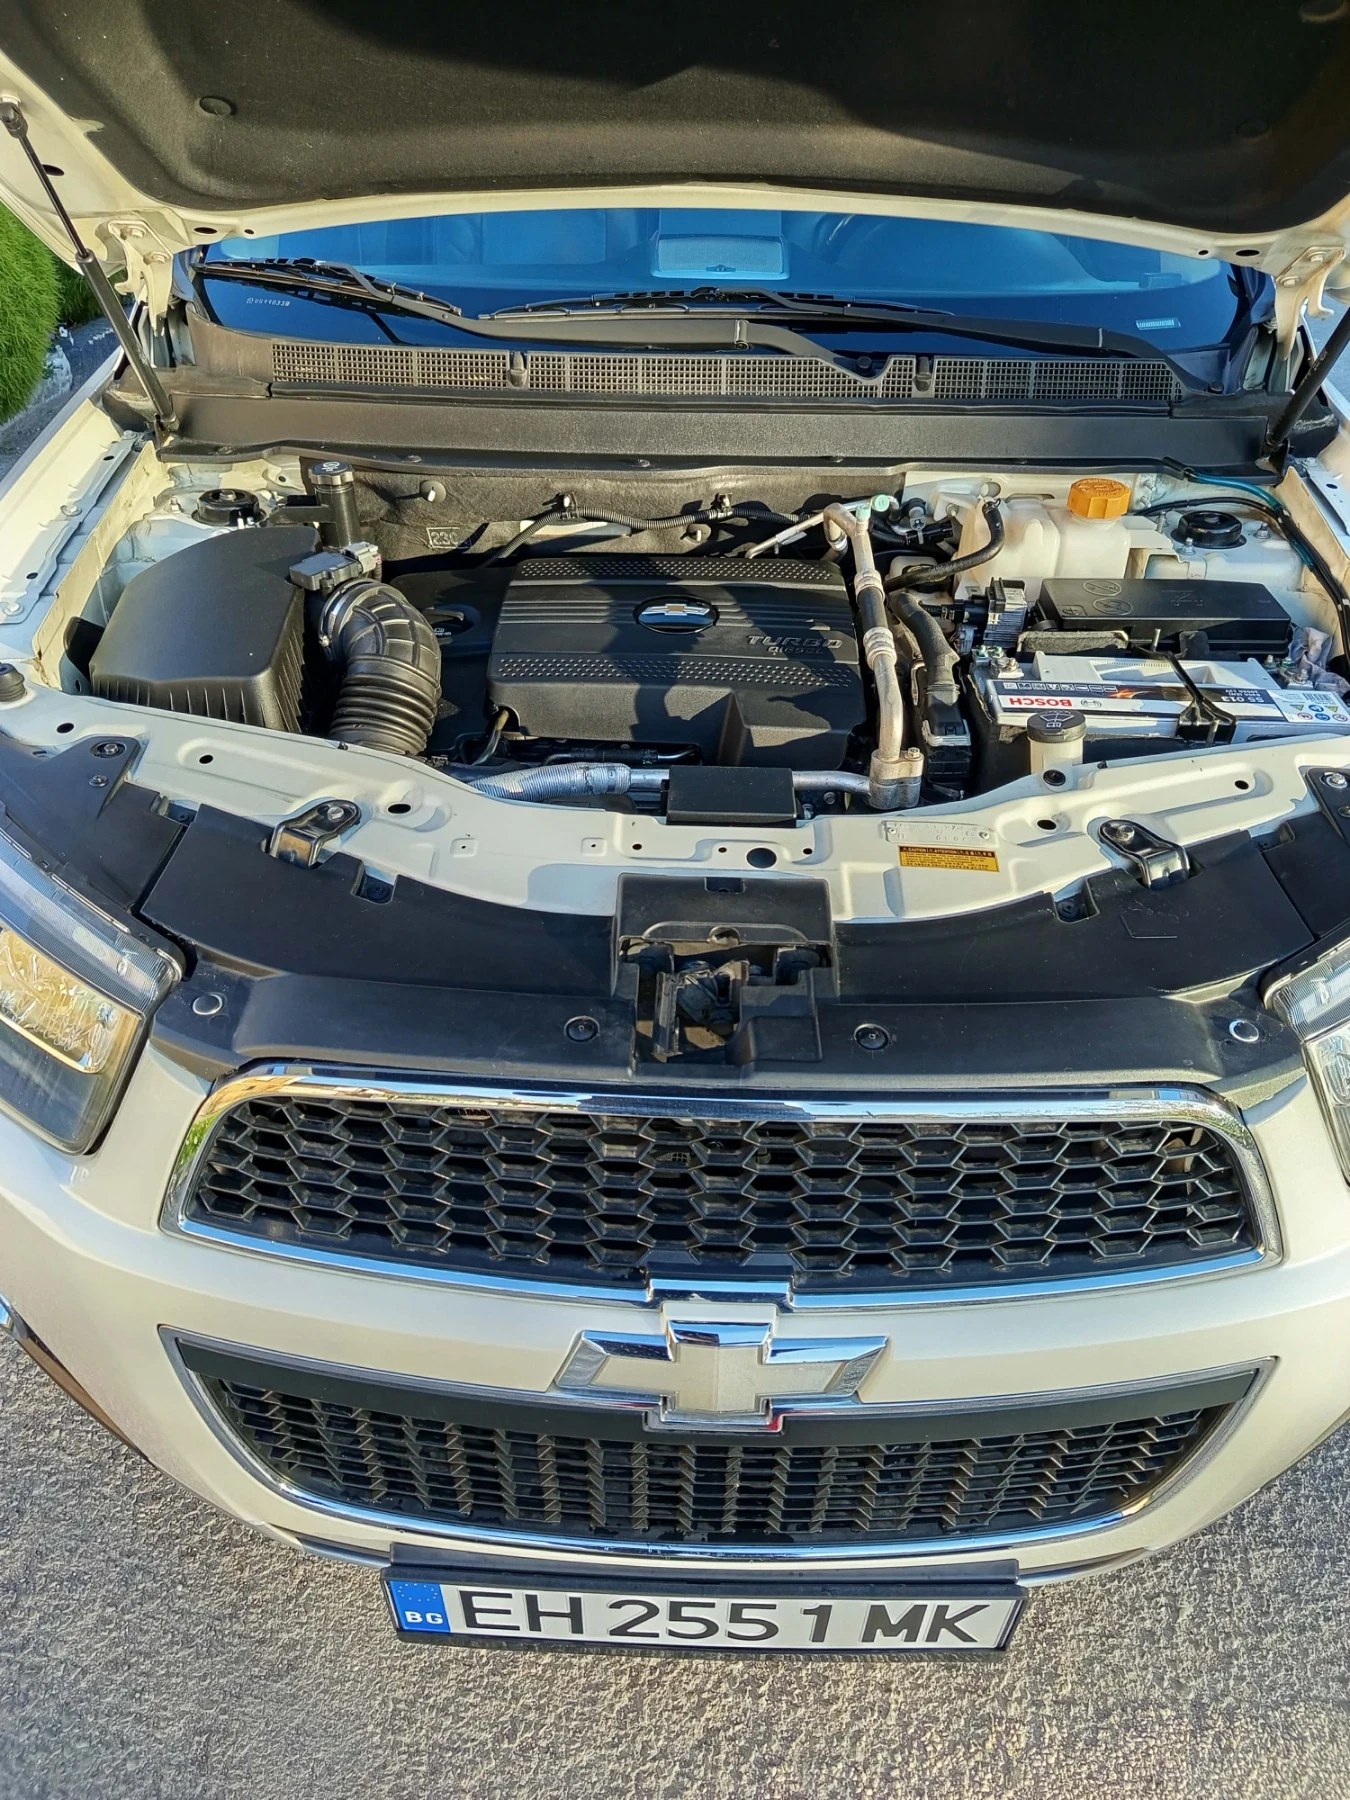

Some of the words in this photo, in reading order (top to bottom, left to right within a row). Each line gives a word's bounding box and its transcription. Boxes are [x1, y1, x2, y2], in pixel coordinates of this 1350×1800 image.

[747, 635, 843, 649] TURBO
[1009, 697, 1072, 707] BOSCH
[405, 1610, 443, 1625] BG
[459, 1590, 584, 1634] EH
[608, 1599, 832, 1643] 2551
[860, 1604, 991, 1643] MK
